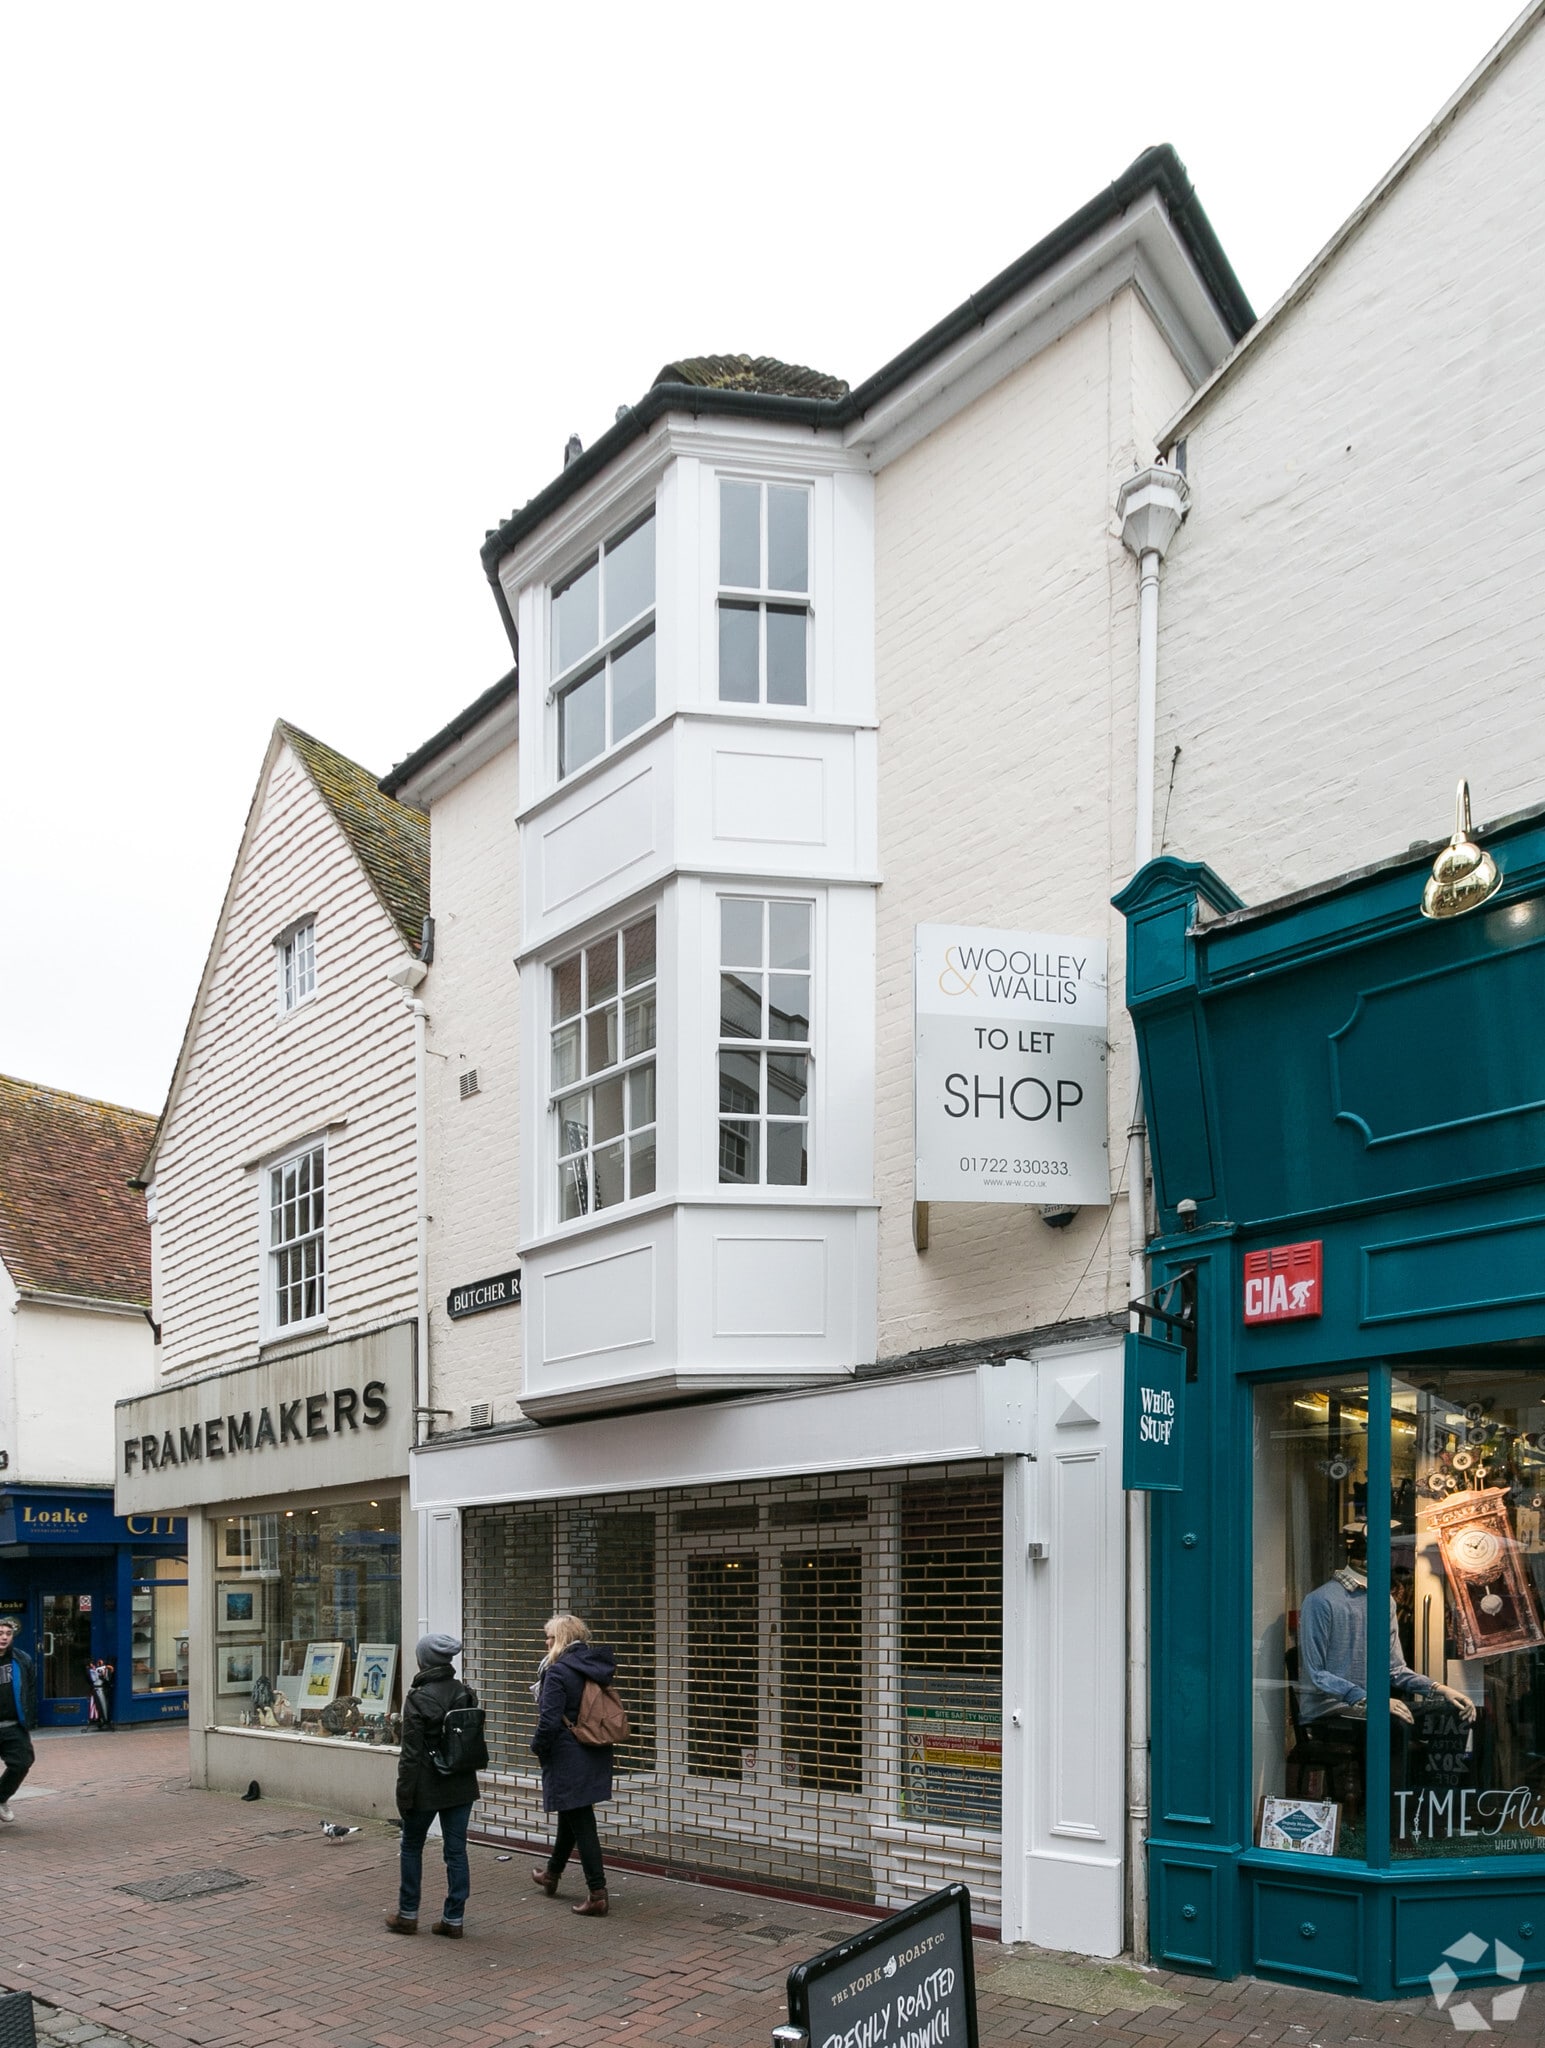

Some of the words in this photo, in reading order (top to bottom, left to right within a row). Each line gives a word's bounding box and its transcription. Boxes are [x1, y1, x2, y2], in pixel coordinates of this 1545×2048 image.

[939, 946, 978, 996] &
[988, 974, 1077, 1005] WALLIS
[959, 946, 1087, 980] WOOLLEY
[974, 1028, 1008, 1051] TO
[1019, 1030, 1055, 1054] LET
[944, 1073, 1083, 1122] SHOP
[960, 1157, 1008, 1173] 01722
[1013, 1160, 1069, 1176] 330333
[454, 1282, 505, 1312] BUTCHER
[511, 1278, 522, 1295] R
[1246, 1274, 1289, 1316] CIA
[124, 1380, 387, 1474] FRAMEMAKERS
[23, 1507, 89, 1524] Loake
[935, 1710, 950, 1718] SITE
[1394, 1787, 1478, 1844] TIME
[1495, 1839, 1514, 1850] WHEN
[831, 1987, 849, 2007] THE
[849, 1967, 882, 1996] YORK
[898, 1936, 934, 1968] ROAST
[897, 1967, 955, 2028] ROASTED
